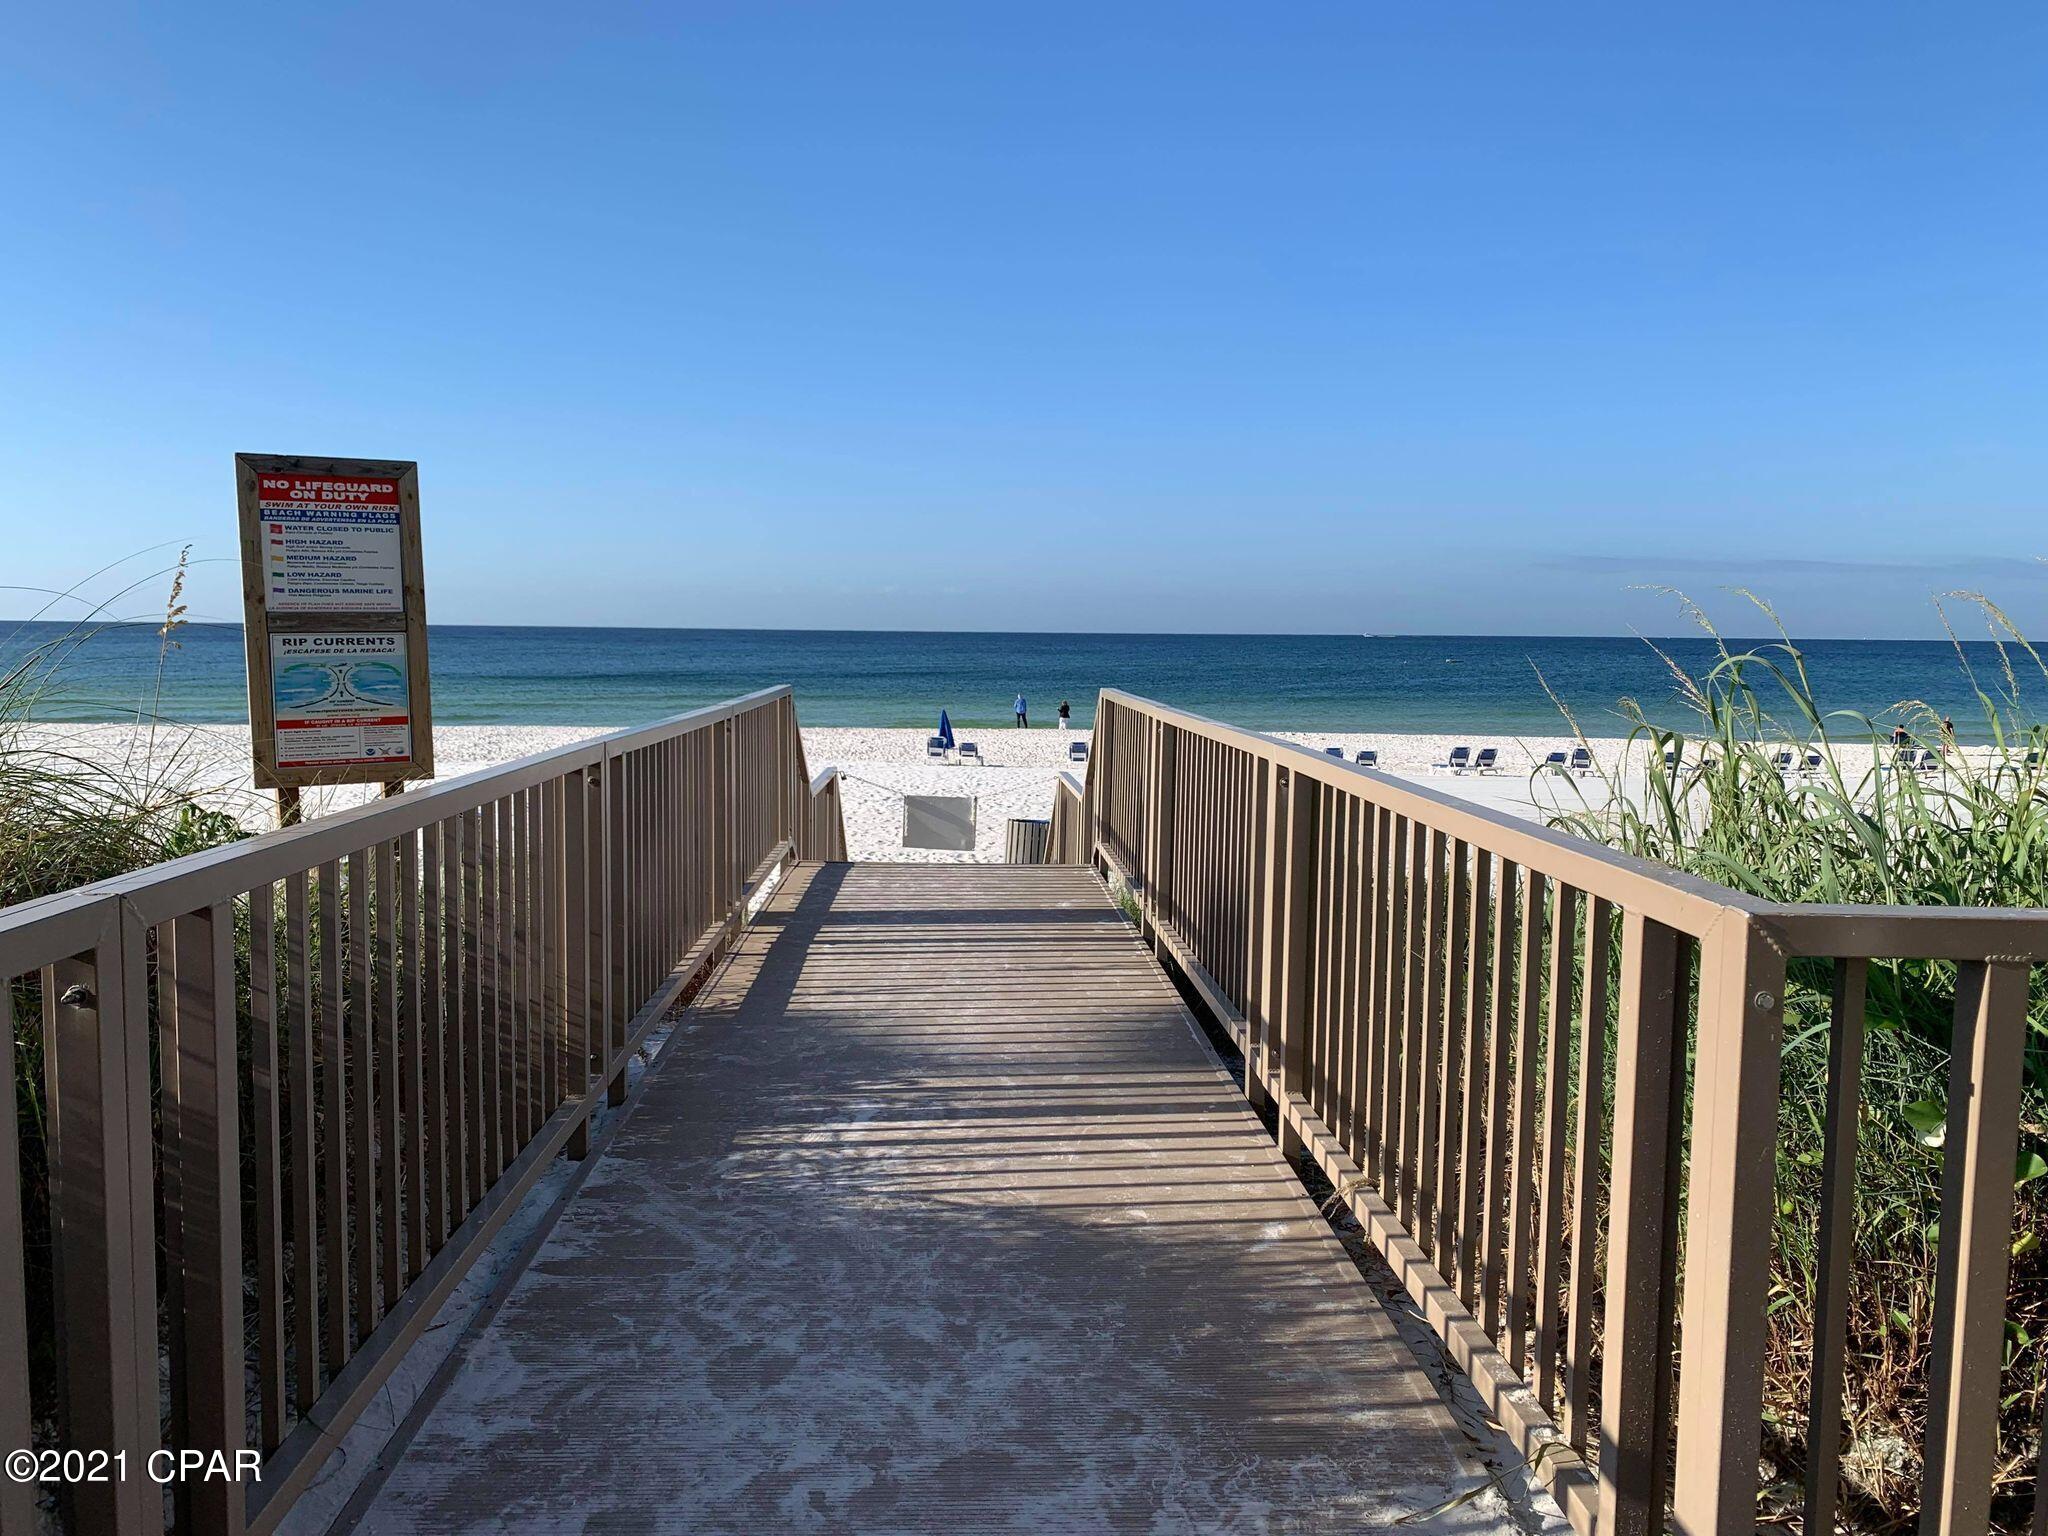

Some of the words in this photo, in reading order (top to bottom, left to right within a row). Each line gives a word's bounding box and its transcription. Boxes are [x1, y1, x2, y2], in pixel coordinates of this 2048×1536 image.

[263, 480, 289, 489] NO
[295, 481, 393, 493] LIFEGUARD
[290, 490, 316, 500] ON
[322, 491, 369, 501] DUTY
[306, 510, 357, 518] WARNING
[282, 638, 307, 646] RIP
[313, 637, 395, 646] CURRENTS
